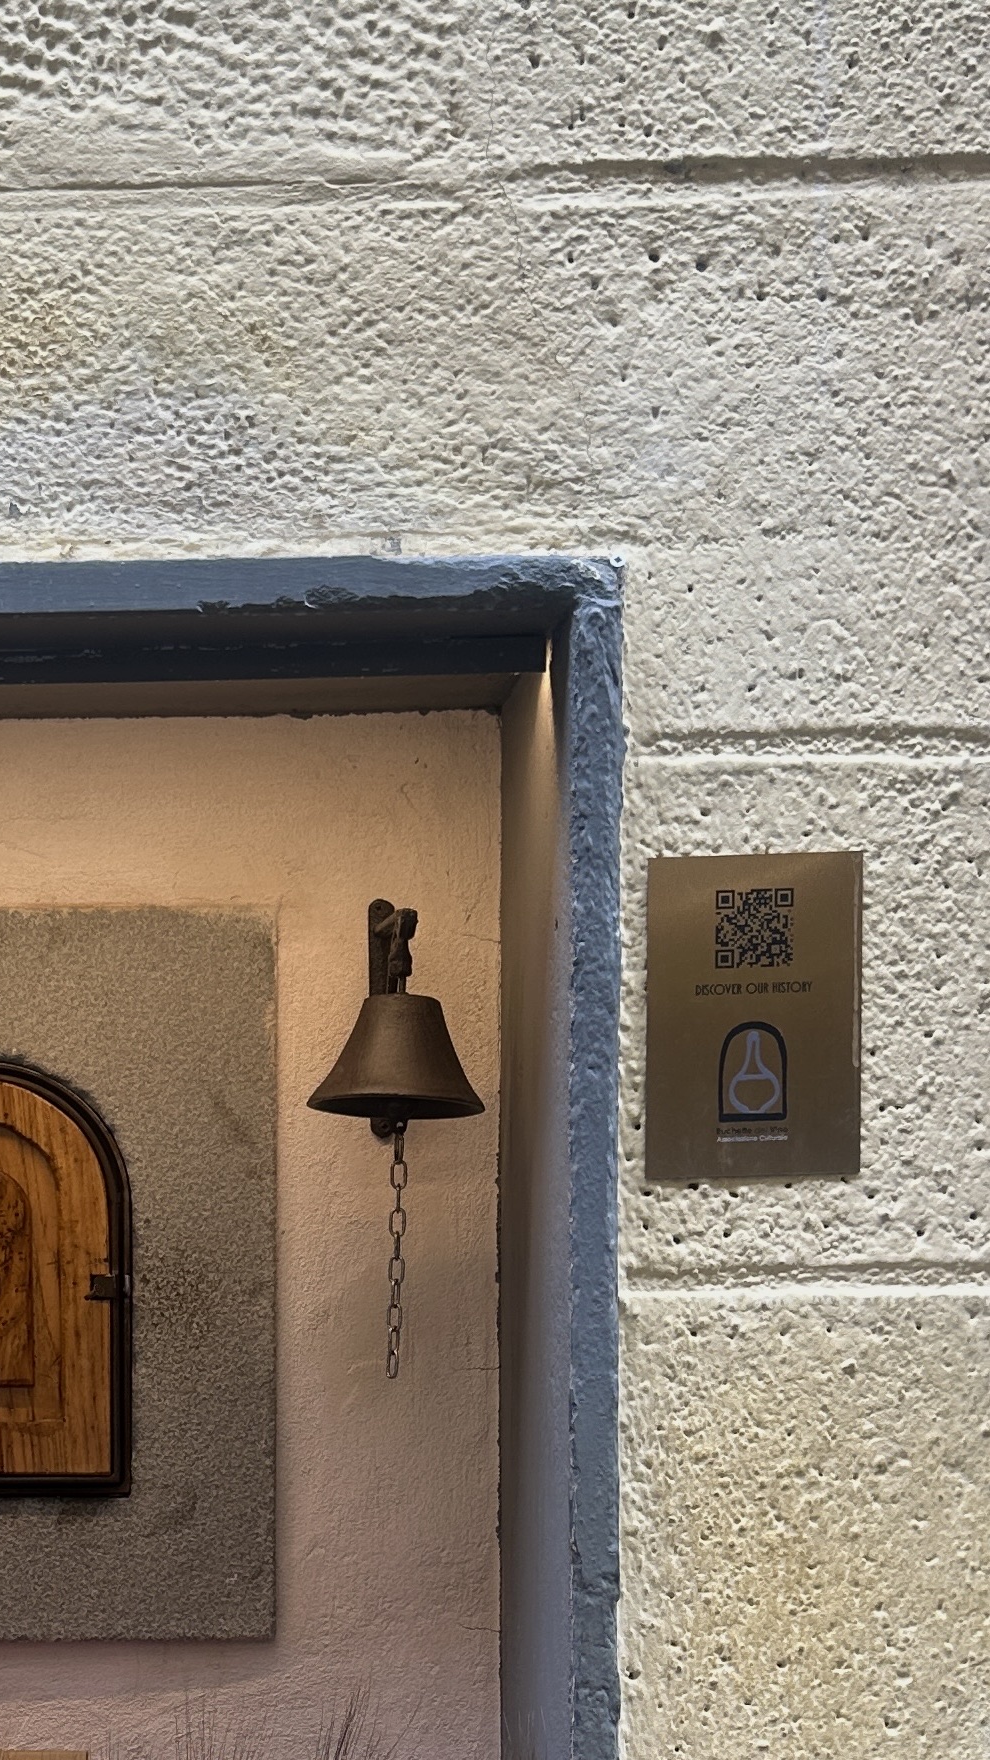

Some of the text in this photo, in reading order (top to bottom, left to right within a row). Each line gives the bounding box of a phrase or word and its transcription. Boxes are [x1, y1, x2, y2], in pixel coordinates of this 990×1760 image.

[695, 981, 812, 996] DISCOVER OUR HISTORY
